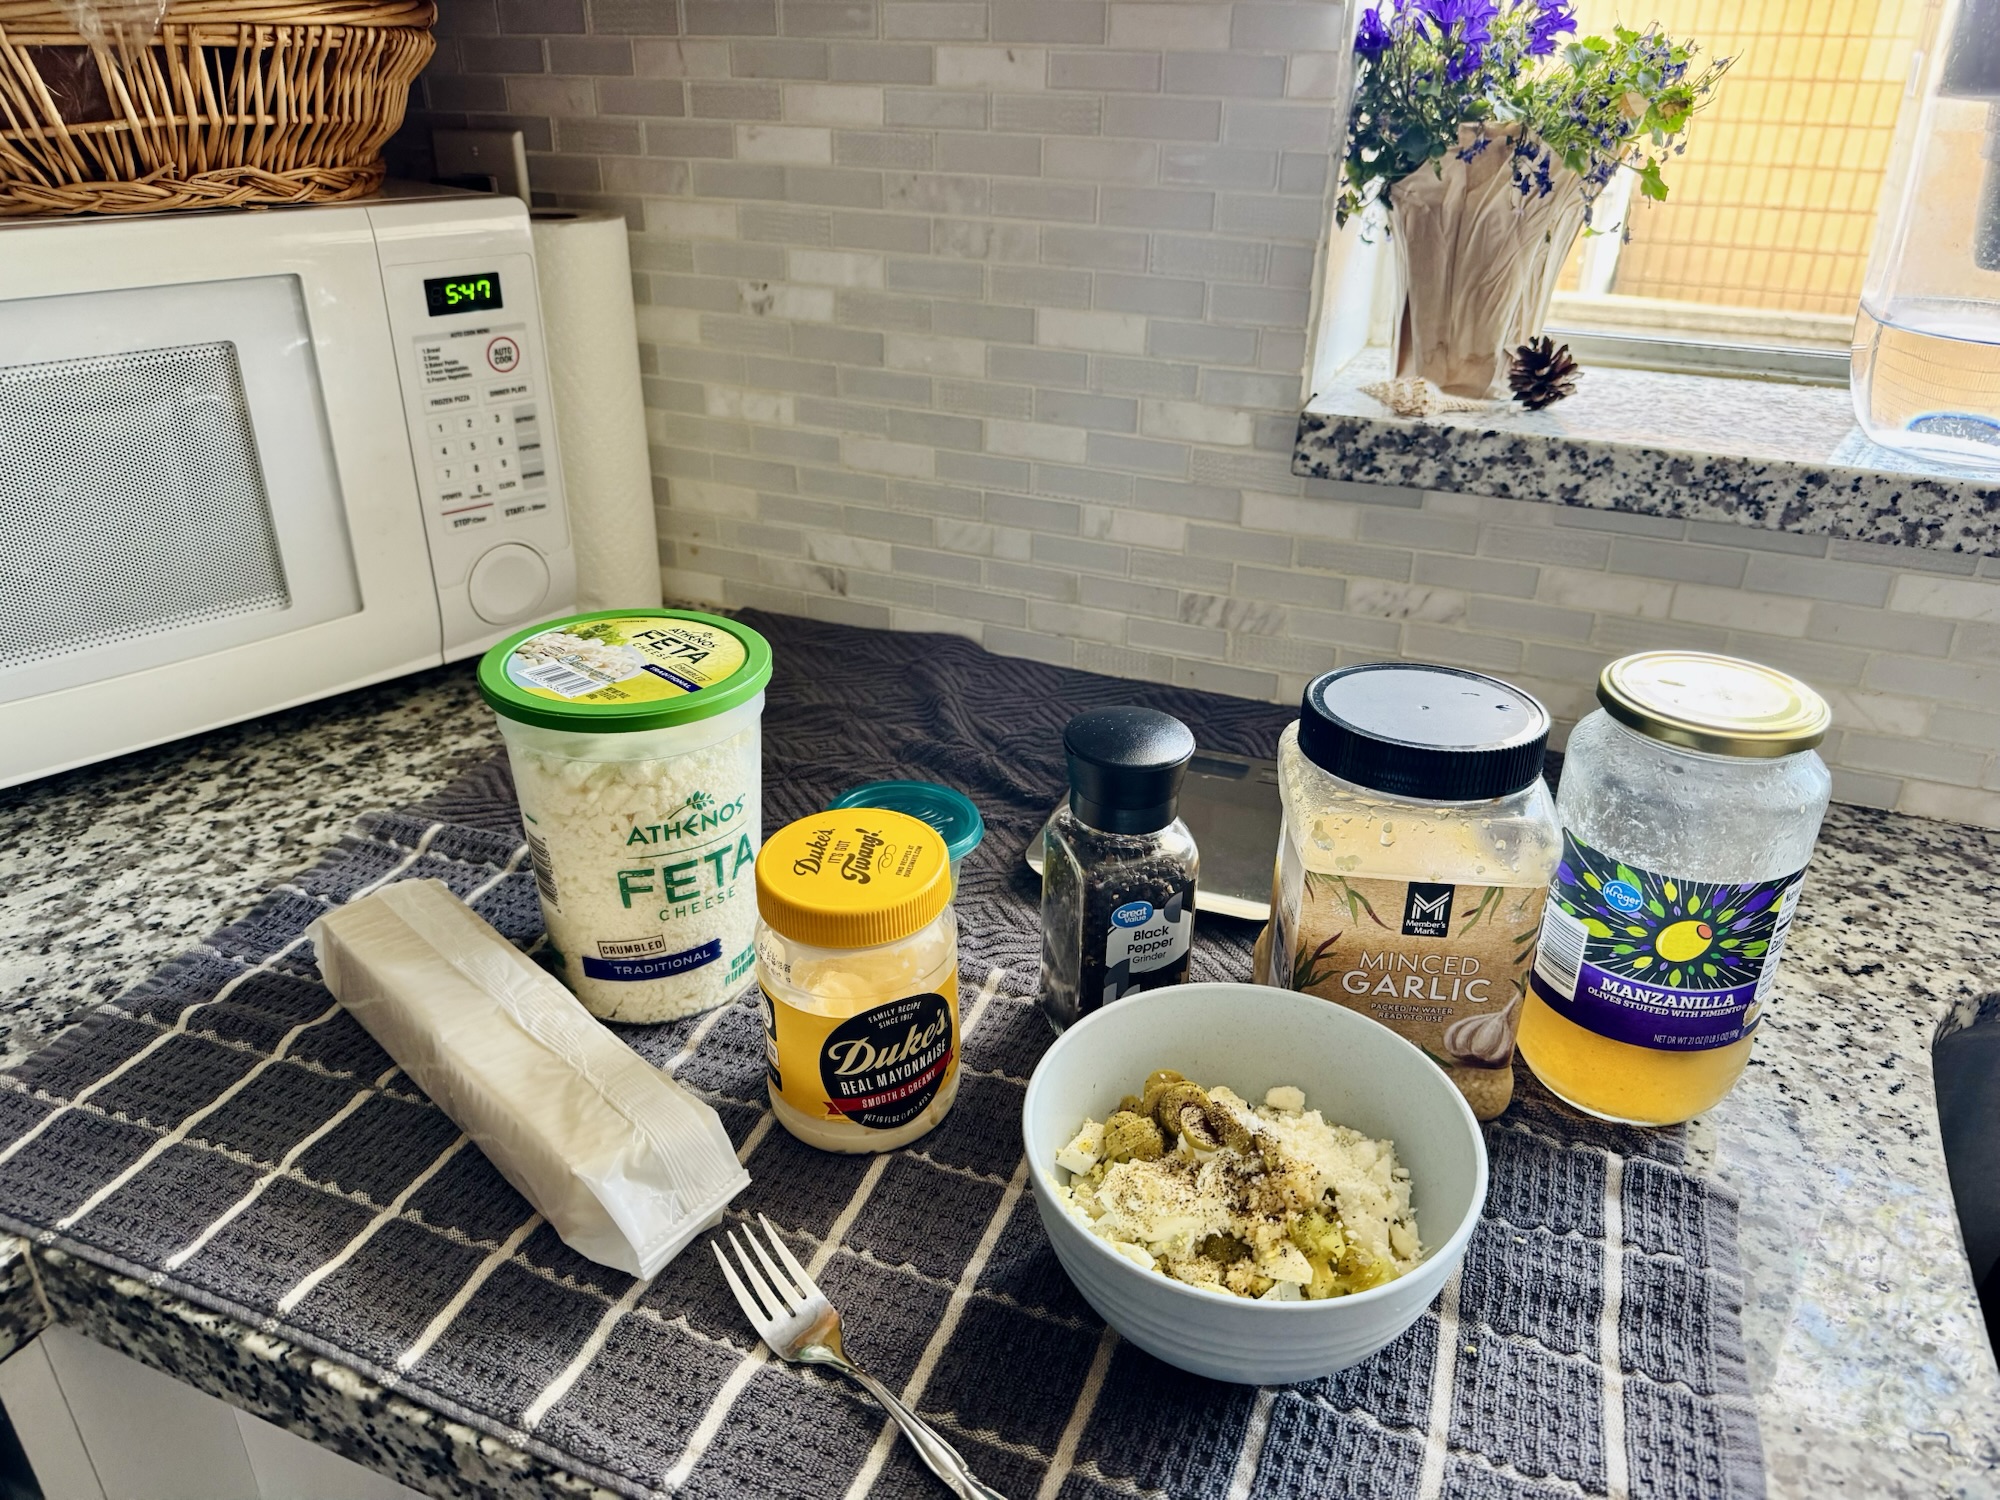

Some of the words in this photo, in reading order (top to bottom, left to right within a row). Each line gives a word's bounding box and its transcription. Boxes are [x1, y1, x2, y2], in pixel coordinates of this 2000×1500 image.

[445, 280, 491, 304] 5:47
[494, 346, 512, 356] AUTO
[494, 355, 513, 365] COOK
[511, 385, 527, 394] PLATE
[430, 397, 453, 406] FROZEN
[454, 394, 470, 403] PIZZA
[467, 419, 472, 428] 2
[495, 414, 500, 423] 3
[438, 424, 443, 433] 1
[470, 442, 476, 451] 5
[498, 437, 504, 446] 6
[442, 447, 447, 455] 4
[474, 464, 480, 473] 8
[502, 459, 507, 468] 9
[446, 470, 451, 479] 7
[477, 484, 483, 493] 0
[499, 481, 516, 490] CLOCK
[442, 492, 462, 501] POWER
[632, 630, 710, 664] FETA
[633, 642, 671, 660] CHEESE
[650, 666, 691, 689] TRADITIONAL
[626, 797, 744, 846] ATHENOS
[793, 828, 836, 876] Duke's
[840, 828, 884, 884] Twang!
[617, 832, 755, 909] FETA
[1605, 886, 1641, 907] Kroger
[659, 886, 736, 922] CHEESE
[1117, 907, 1147, 919] Great
[1124, 914, 1147, 923] Value
[1405, 919, 1446, 930] Member's
[1133, 926, 1169, 942] Black
[602, 940, 663, 955] CRUMBLED
[1127, 936, 1174, 955] Pepper
[613, 950, 711, 975] TRADITIONAL
[1132, 951, 1167, 964] Grinder
[1359, 950, 1481, 976] MINCED
[1341, 970, 1492, 1004] GARLIC
[1600, 977, 1736, 1010] MANZANILLA
[1371, 1003, 1407, 1013] PACKED
[1408, 1005, 1419, 1013] IN
[1422, 1007, 1453, 1015] WATER
[1588, 986, 1622, 1005] OLIVES
[1623, 999, 1670, 1016] STUFFED
[1671, 1008, 1698, 1018] WITH
[1700, 1005, 1742, 1019] PIMIENTO
[868, 1008, 895, 1024] FAMILY
[898, 1001, 921, 1014] RECIPE
[1378, 1012, 1409, 1021] READY
[1409, 1014, 1424, 1022] TO
[1426, 1015, 1444, 1023] USE
[879, 1016, 898, 1029] SINCE
[900, 1013, 913, 1022] 1917
[828, 1008, 947, 1075] Duke's
[1654, 1034, 1667, 1043] NET
[1667, 1036, 1676, 1044] DR
[1677, 1037, 1688, 1045] WT
[840, 1077, 874, 1095] REAL
[877, 1038, 946, 1087] MAYONNAISE
[862, 1091, 898, 1109] SMOOTH
[900, 1089, 906, 1098] &
[908, 1068, 937, 1094] CREAMY
